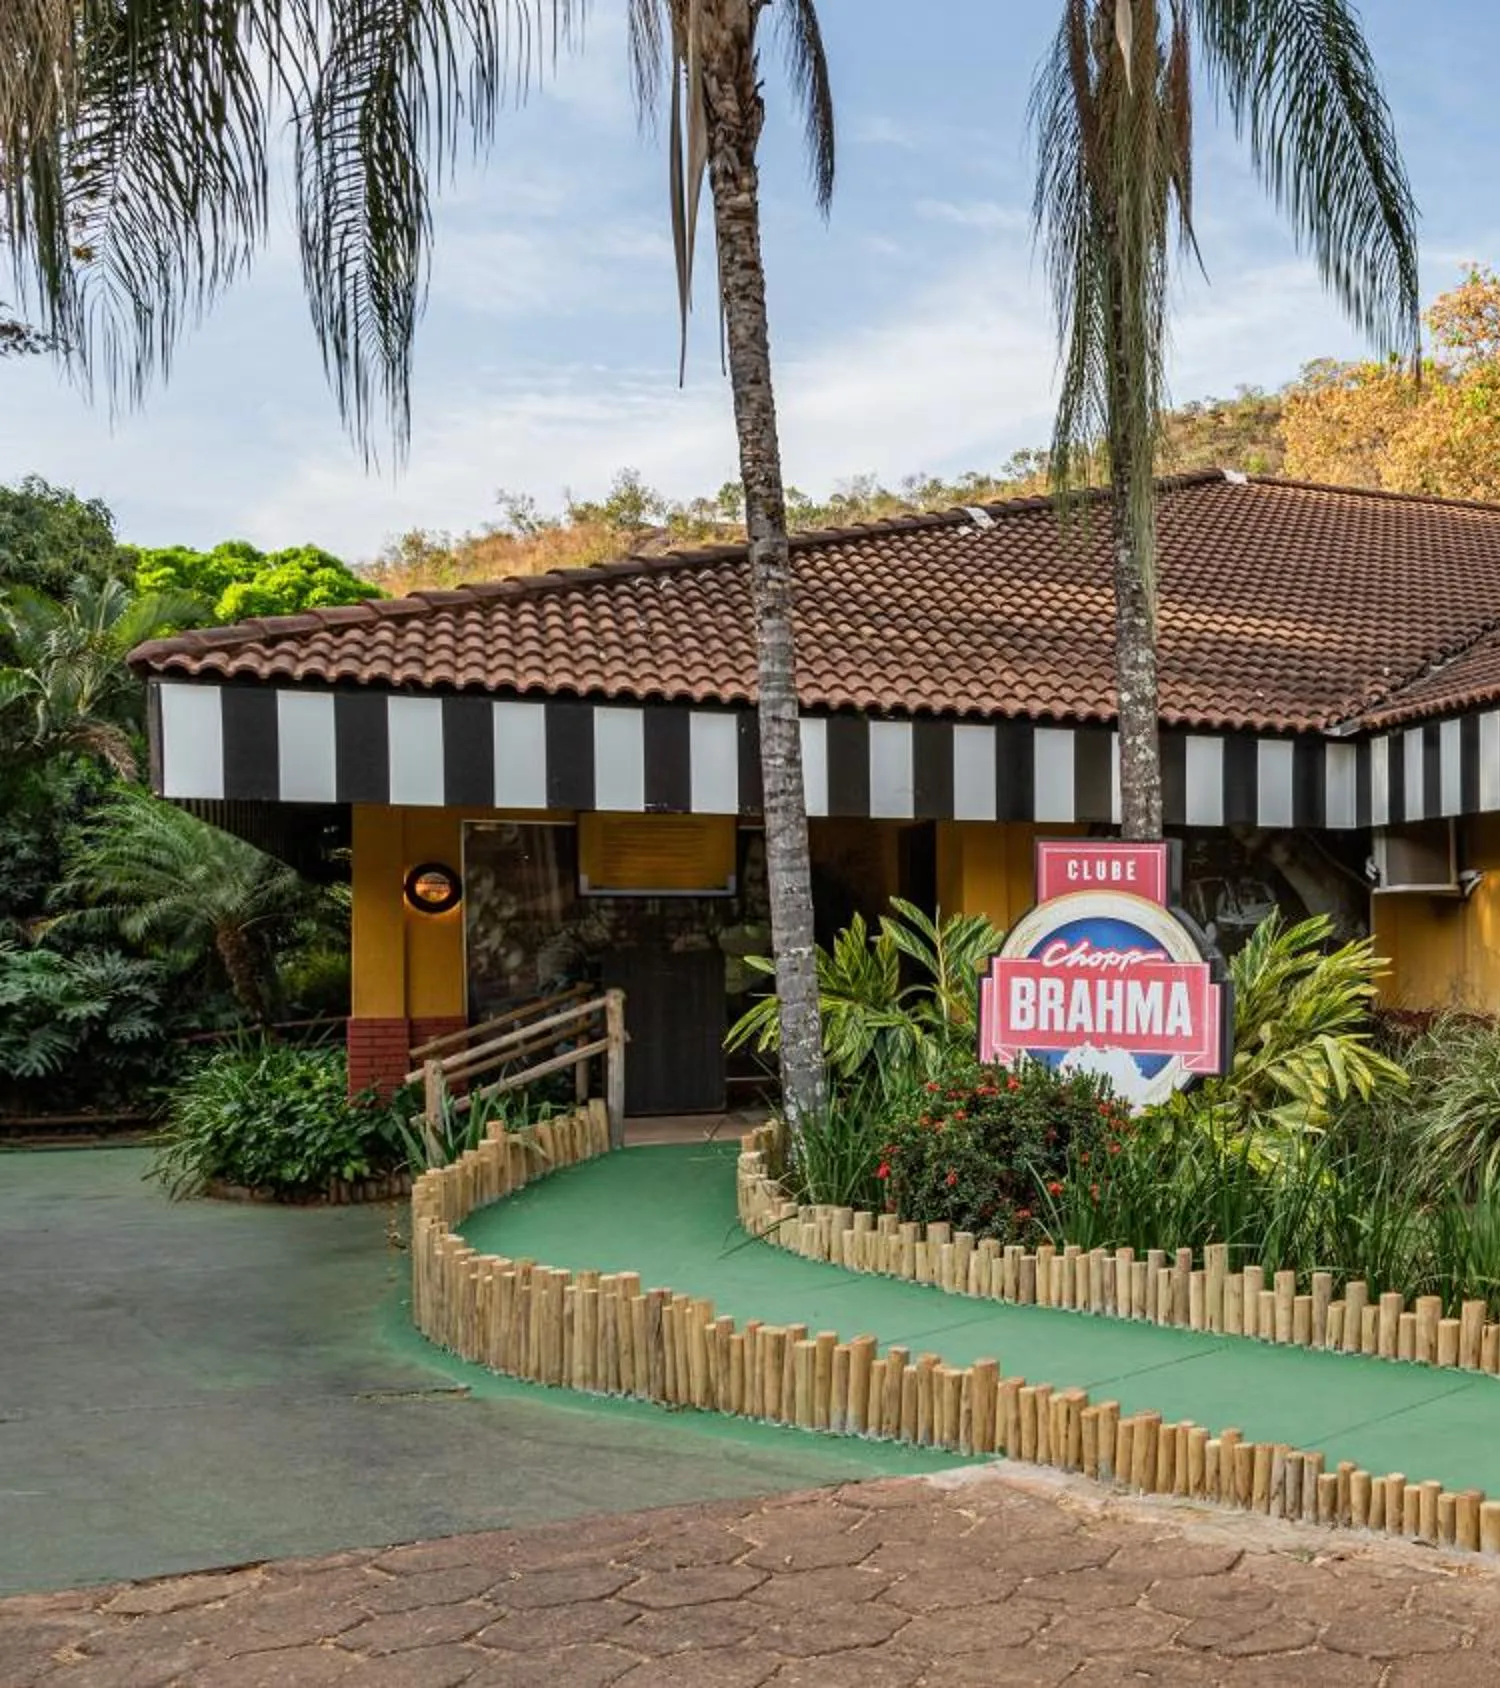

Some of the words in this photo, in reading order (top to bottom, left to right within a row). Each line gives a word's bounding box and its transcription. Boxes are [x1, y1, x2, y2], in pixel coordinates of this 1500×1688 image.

[1067, 859, 1137, 881] CLUBE
[1042, 940, 1165, 972] Chopp
[1009, 976, 1193, 1037] BRAHMA
